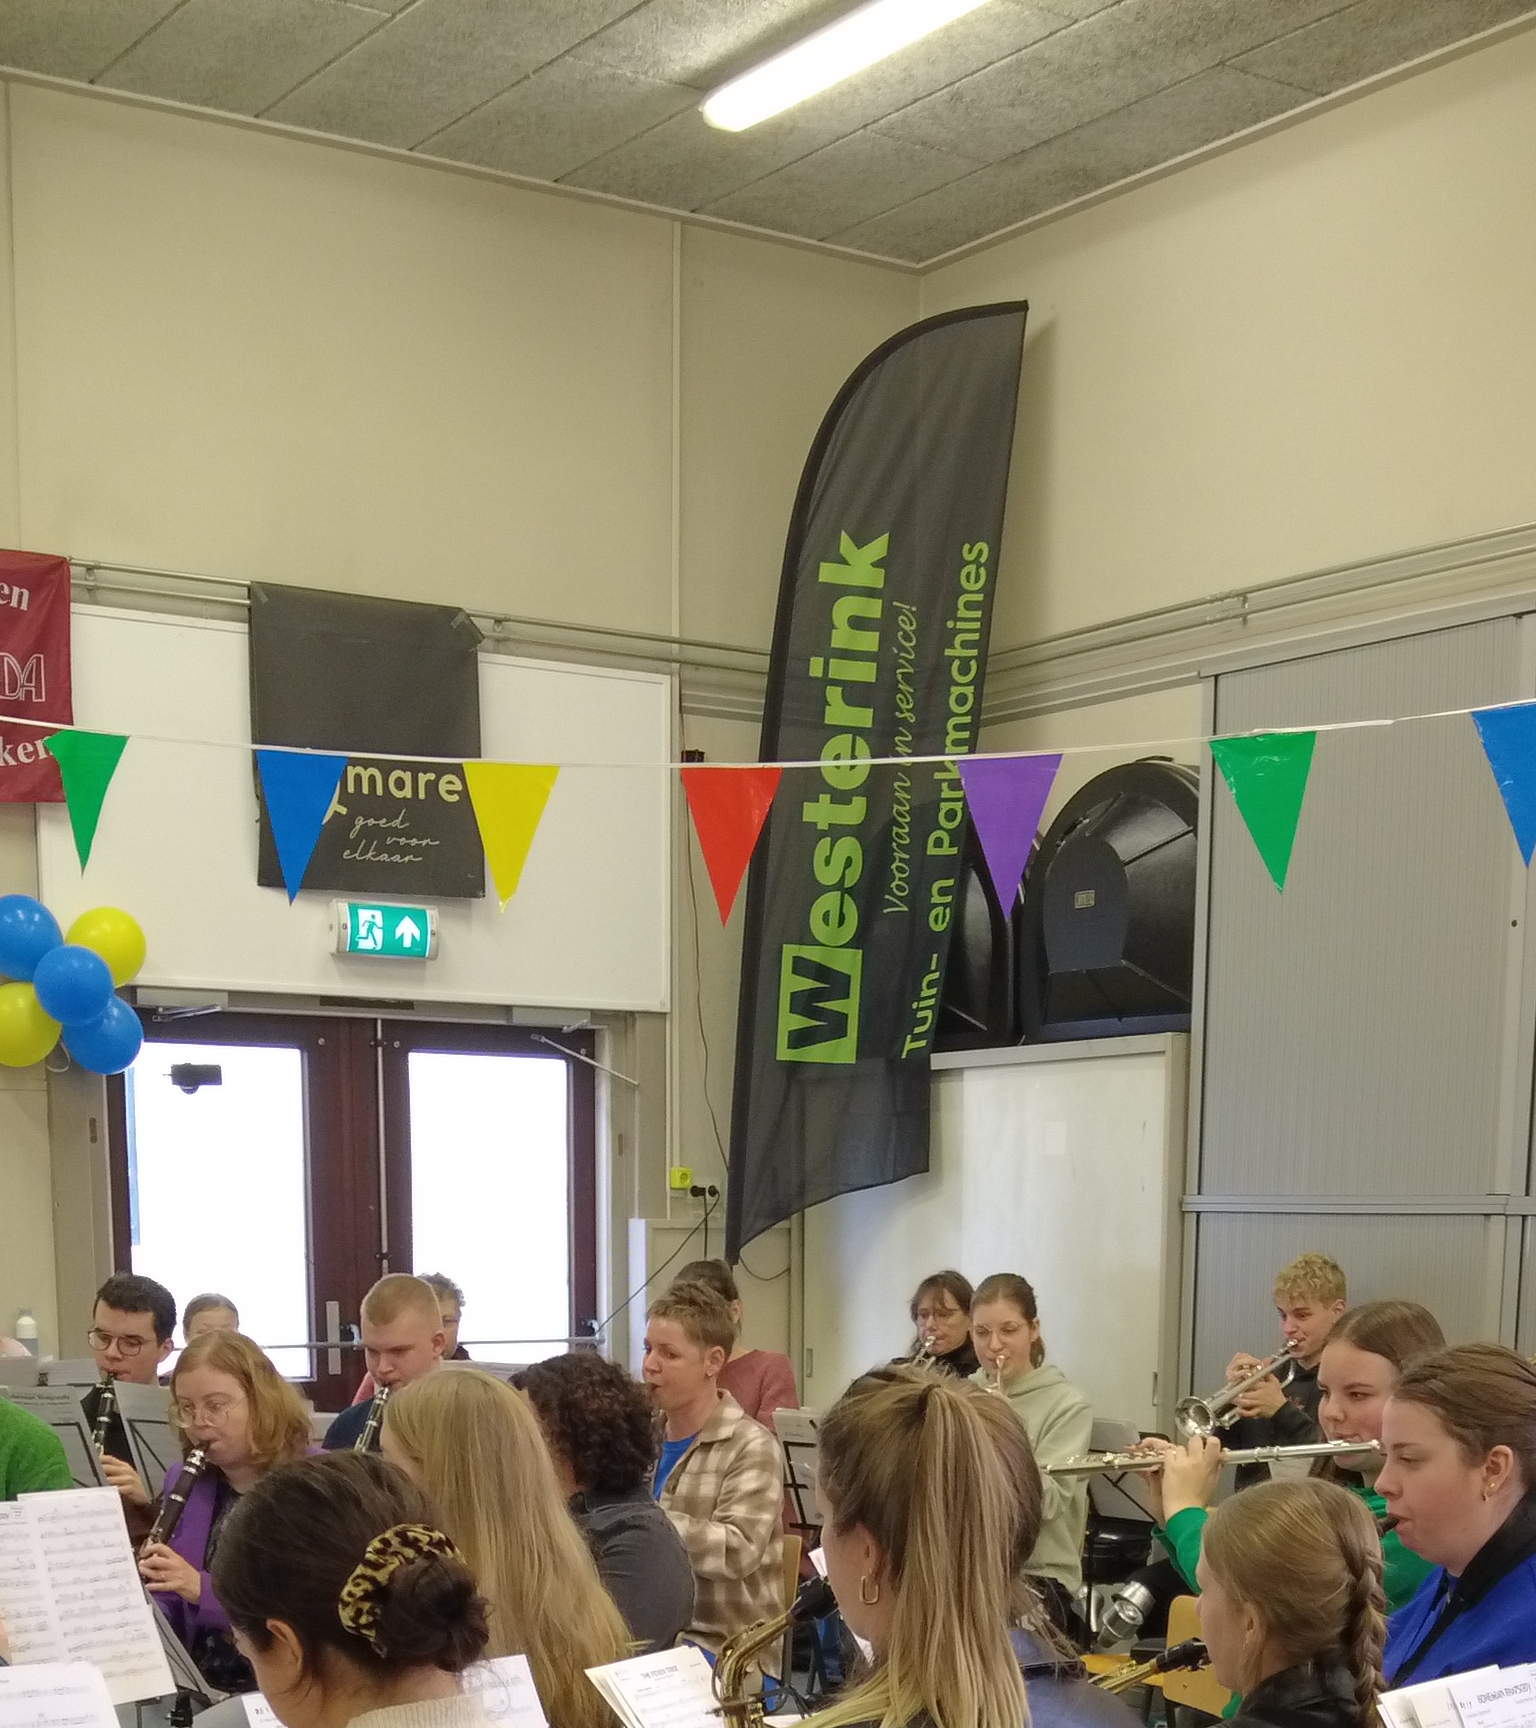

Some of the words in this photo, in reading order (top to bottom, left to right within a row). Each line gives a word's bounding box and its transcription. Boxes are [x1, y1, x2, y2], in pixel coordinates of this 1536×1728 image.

[892, 601, 917, 724] service!
[926, 541, 990, 856] Parkmachines
[349, 808, 411, 840] goed
[385, 834, 441, 847] voor
[777, 528, 891, 1063] Westerink
[882, 772, 912, 914] Vooraan
[342, 838, 423, 864] elkaar
[928, 877, 956, 933] en
[901, 953, 941, 1060] Tuin-
